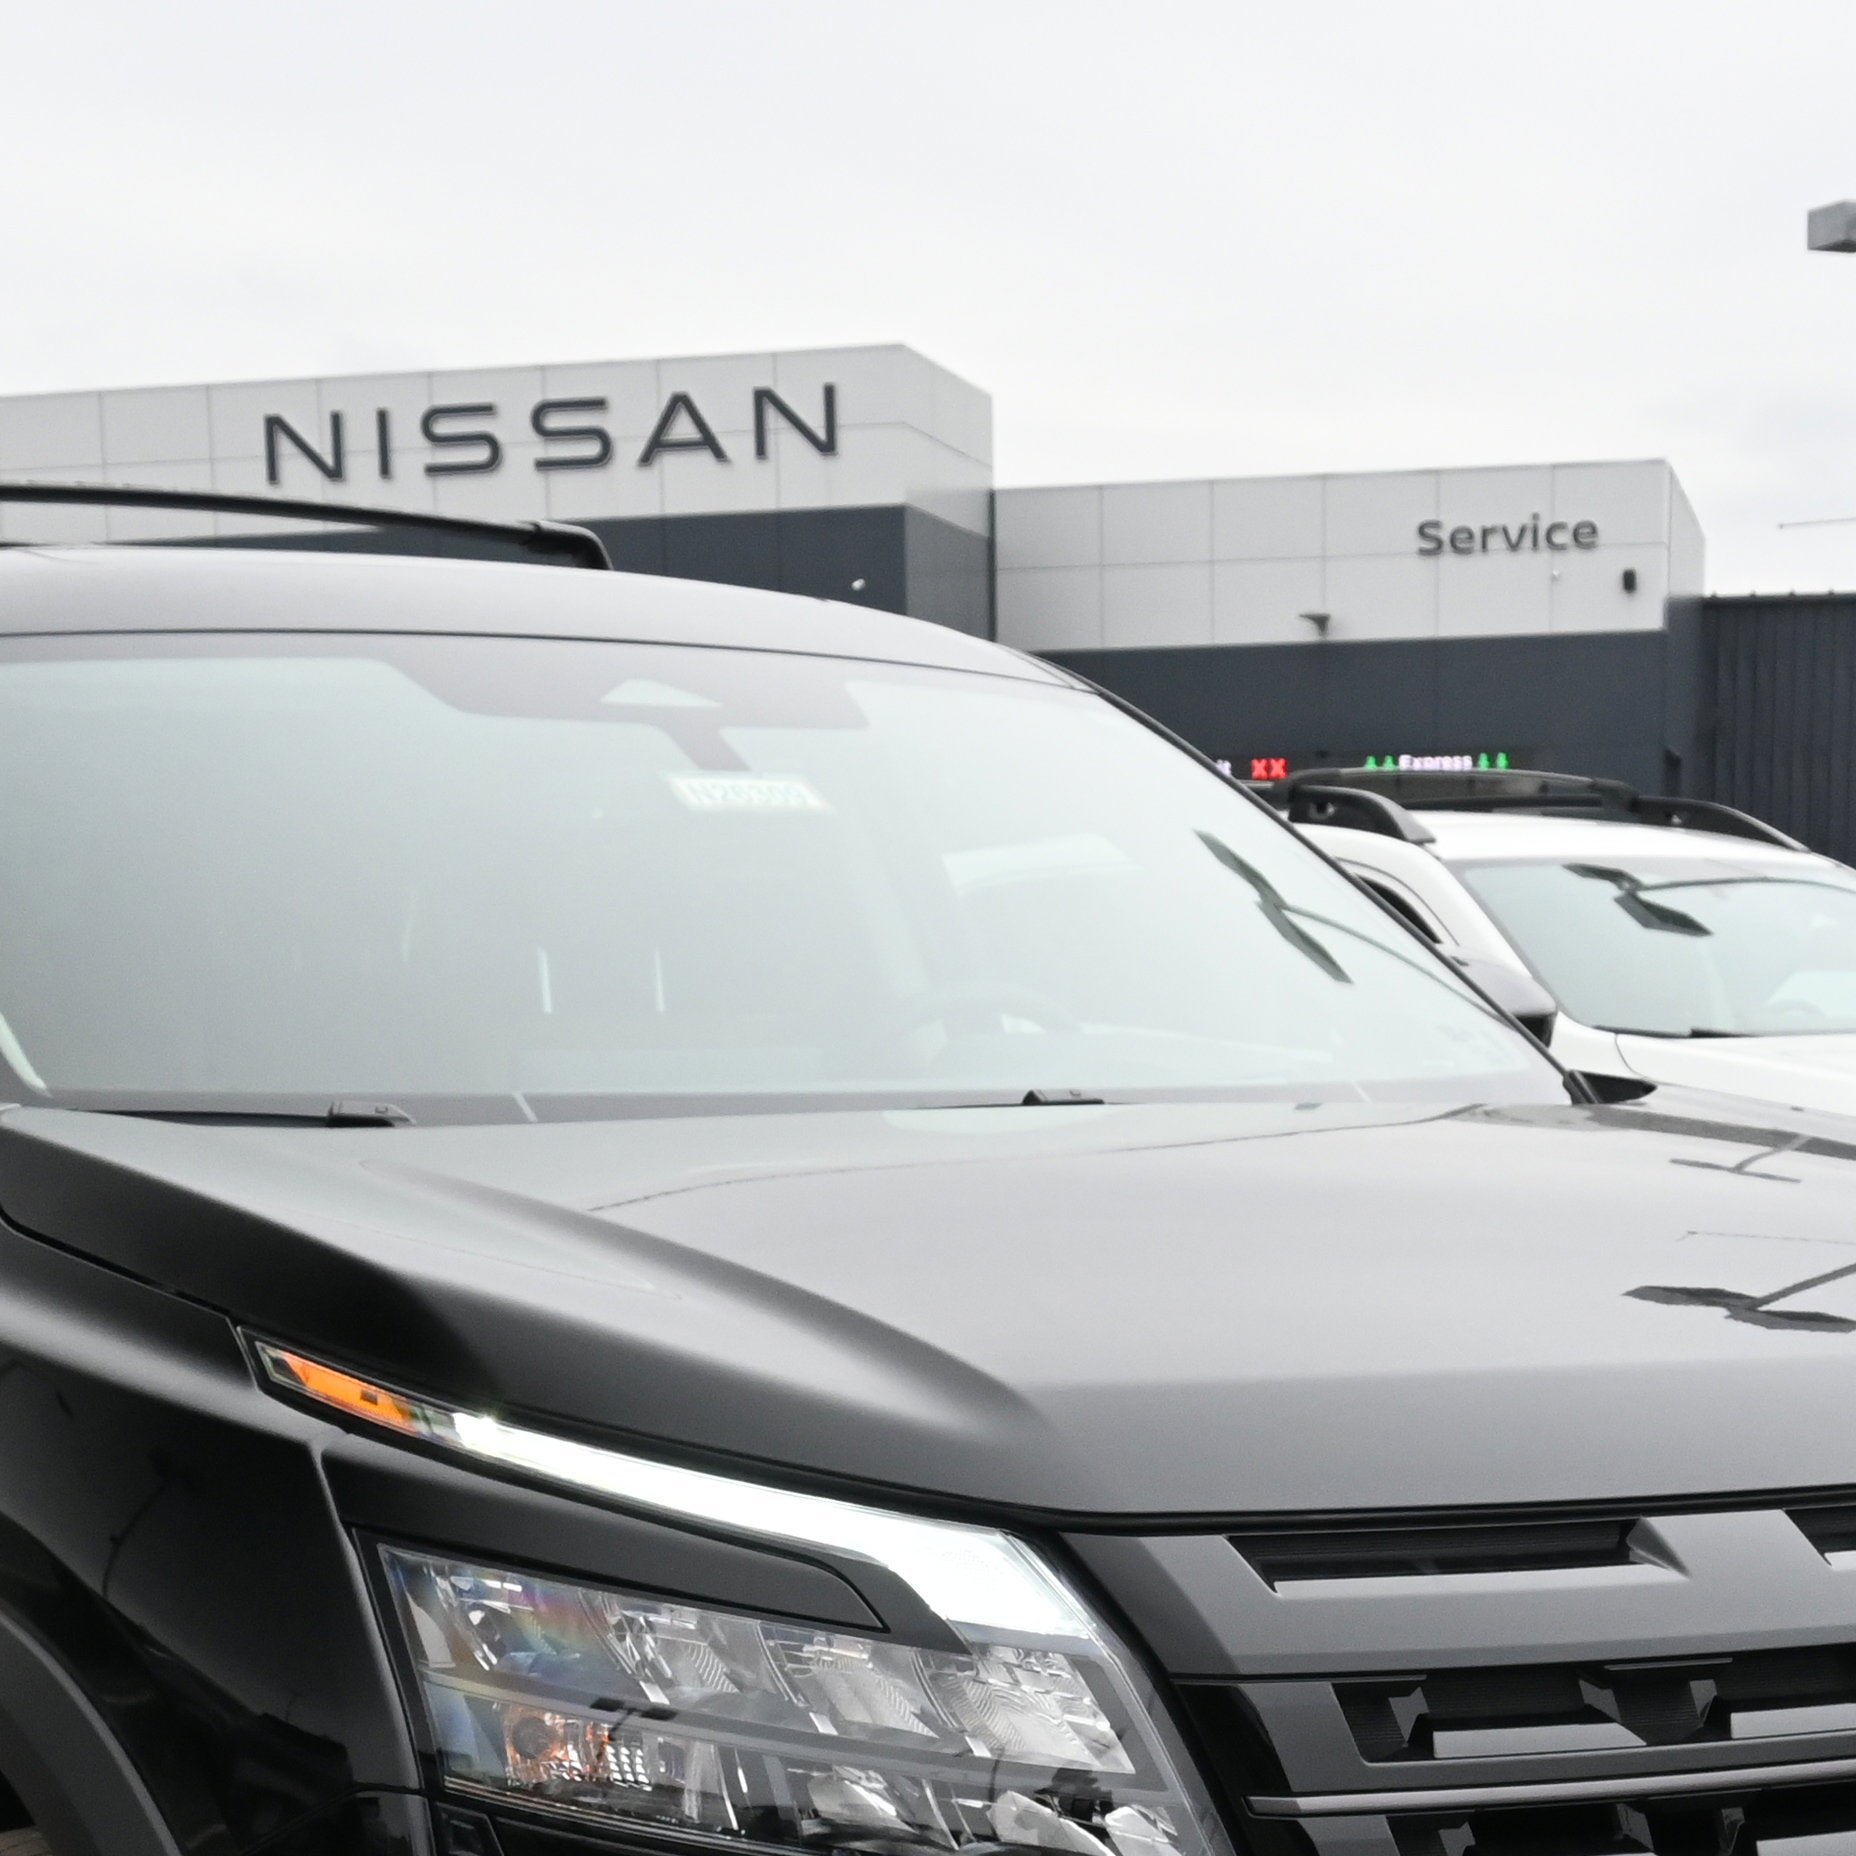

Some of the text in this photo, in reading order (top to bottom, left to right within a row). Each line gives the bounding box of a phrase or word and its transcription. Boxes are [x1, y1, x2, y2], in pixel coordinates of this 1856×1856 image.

[262, 382, 841, 486] NISSAN
[1416, 511, 1600, 558] Service
[1398, 754, 1473, 771] Express
